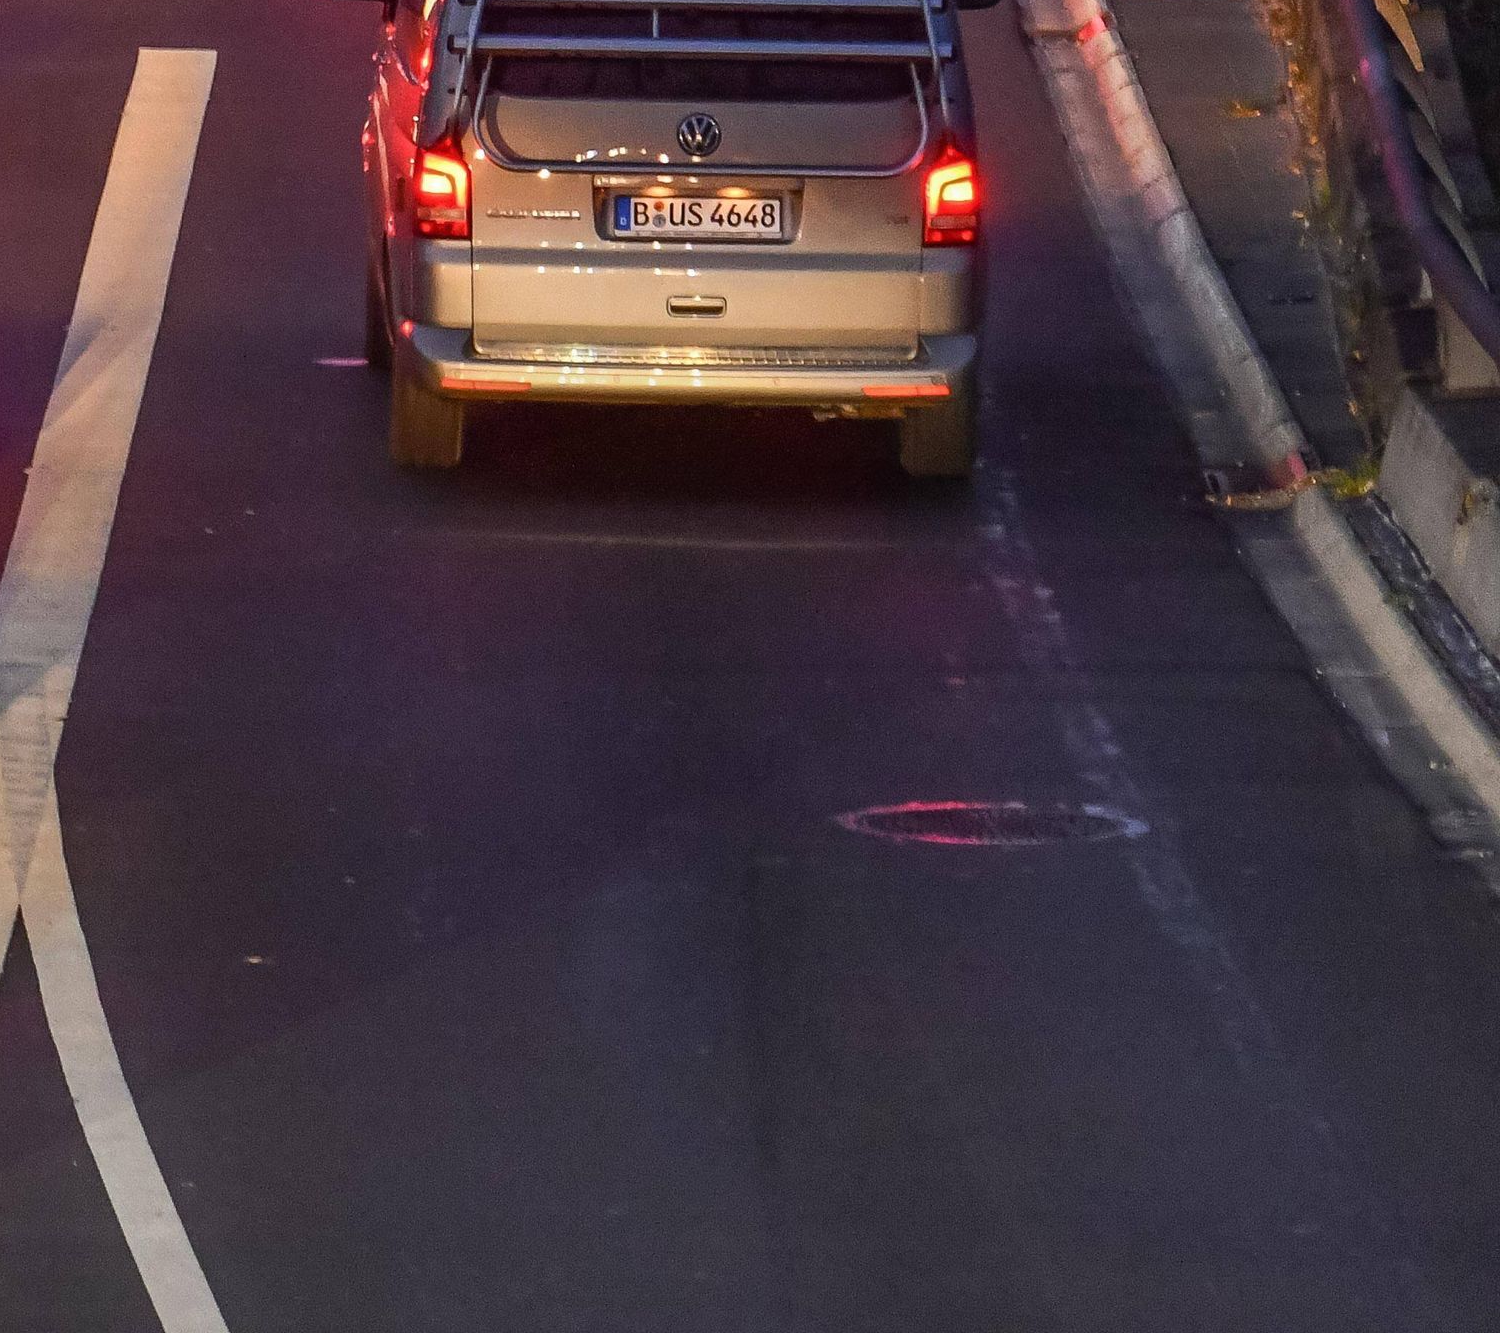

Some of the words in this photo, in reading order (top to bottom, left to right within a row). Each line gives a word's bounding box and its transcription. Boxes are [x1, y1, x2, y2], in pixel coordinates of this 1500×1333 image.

[633, 202, 649, 226] B
[669, 202, 703, 226] US
[709, 202, 776, 228] 4648
